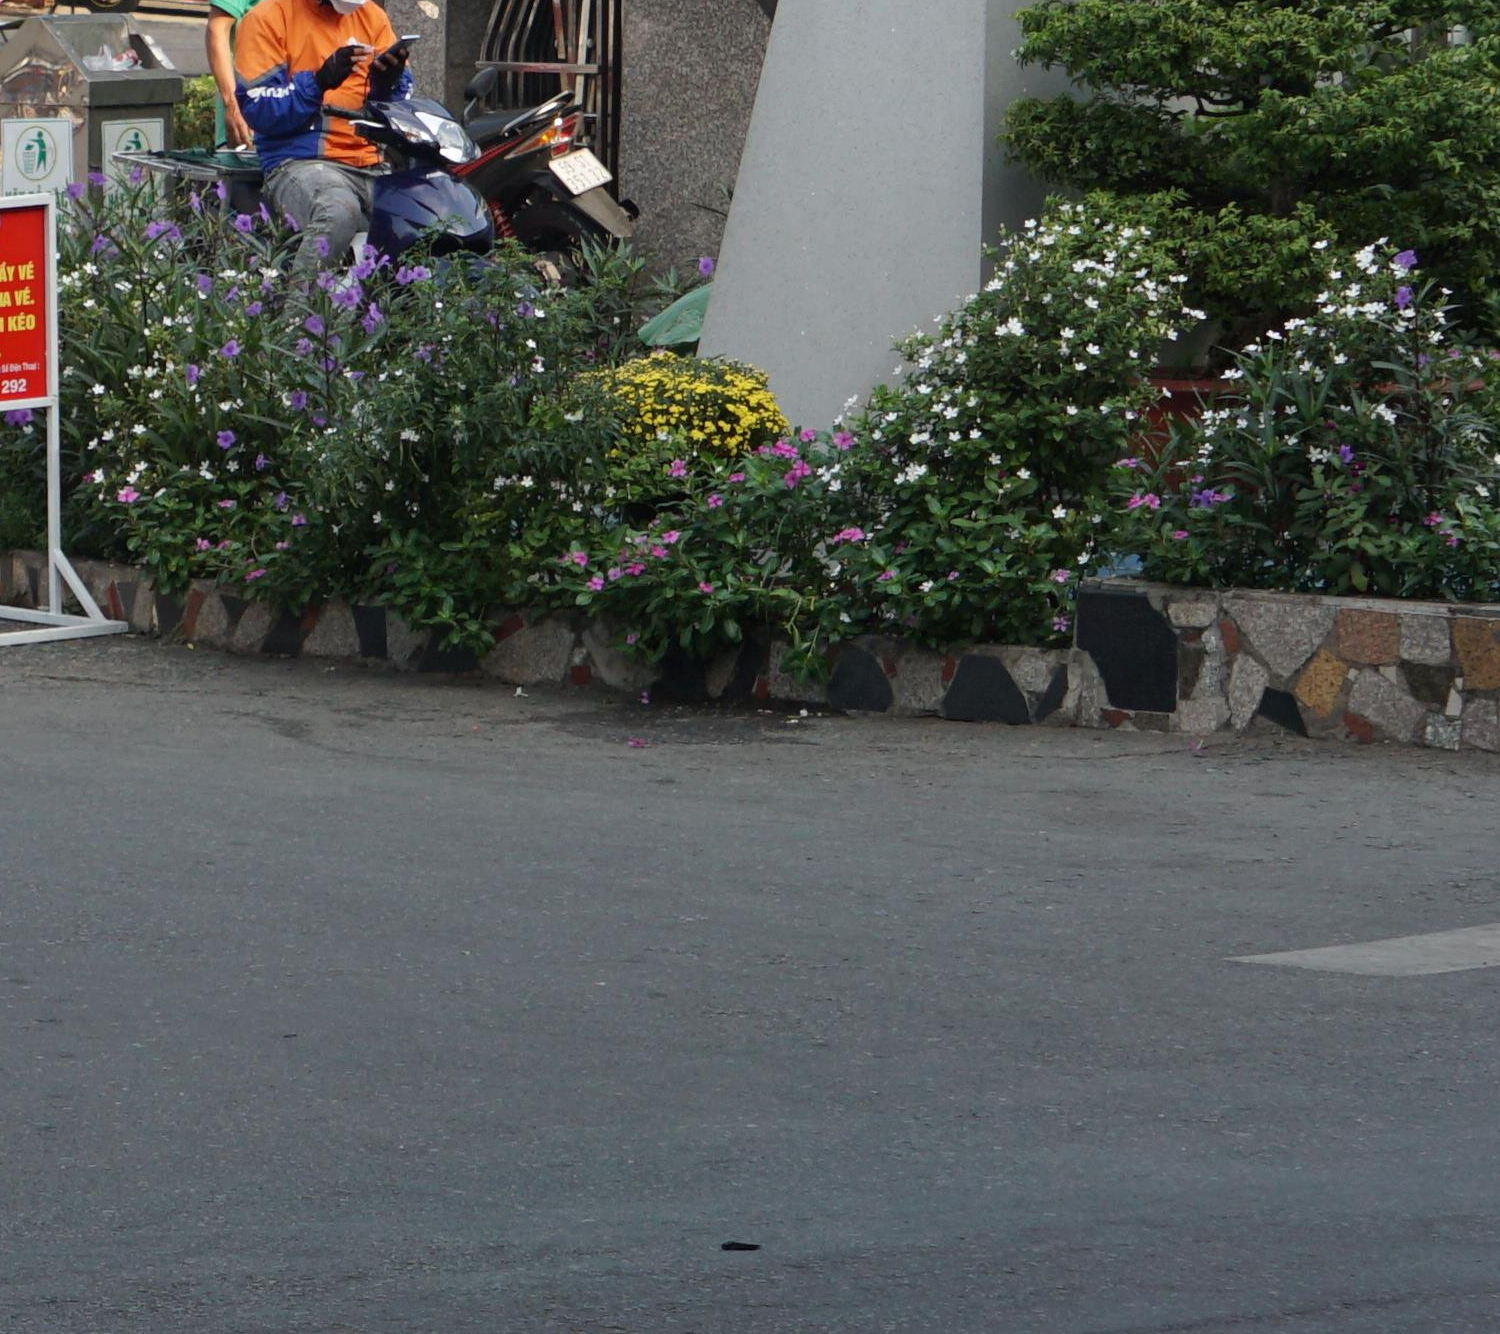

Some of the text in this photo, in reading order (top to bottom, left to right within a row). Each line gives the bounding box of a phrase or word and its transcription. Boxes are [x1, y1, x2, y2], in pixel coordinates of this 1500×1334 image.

[17, 260, 35, 281] VÉ
[7, 313, 36, 332] KÉO
[1, 378, 27, 394] 292
